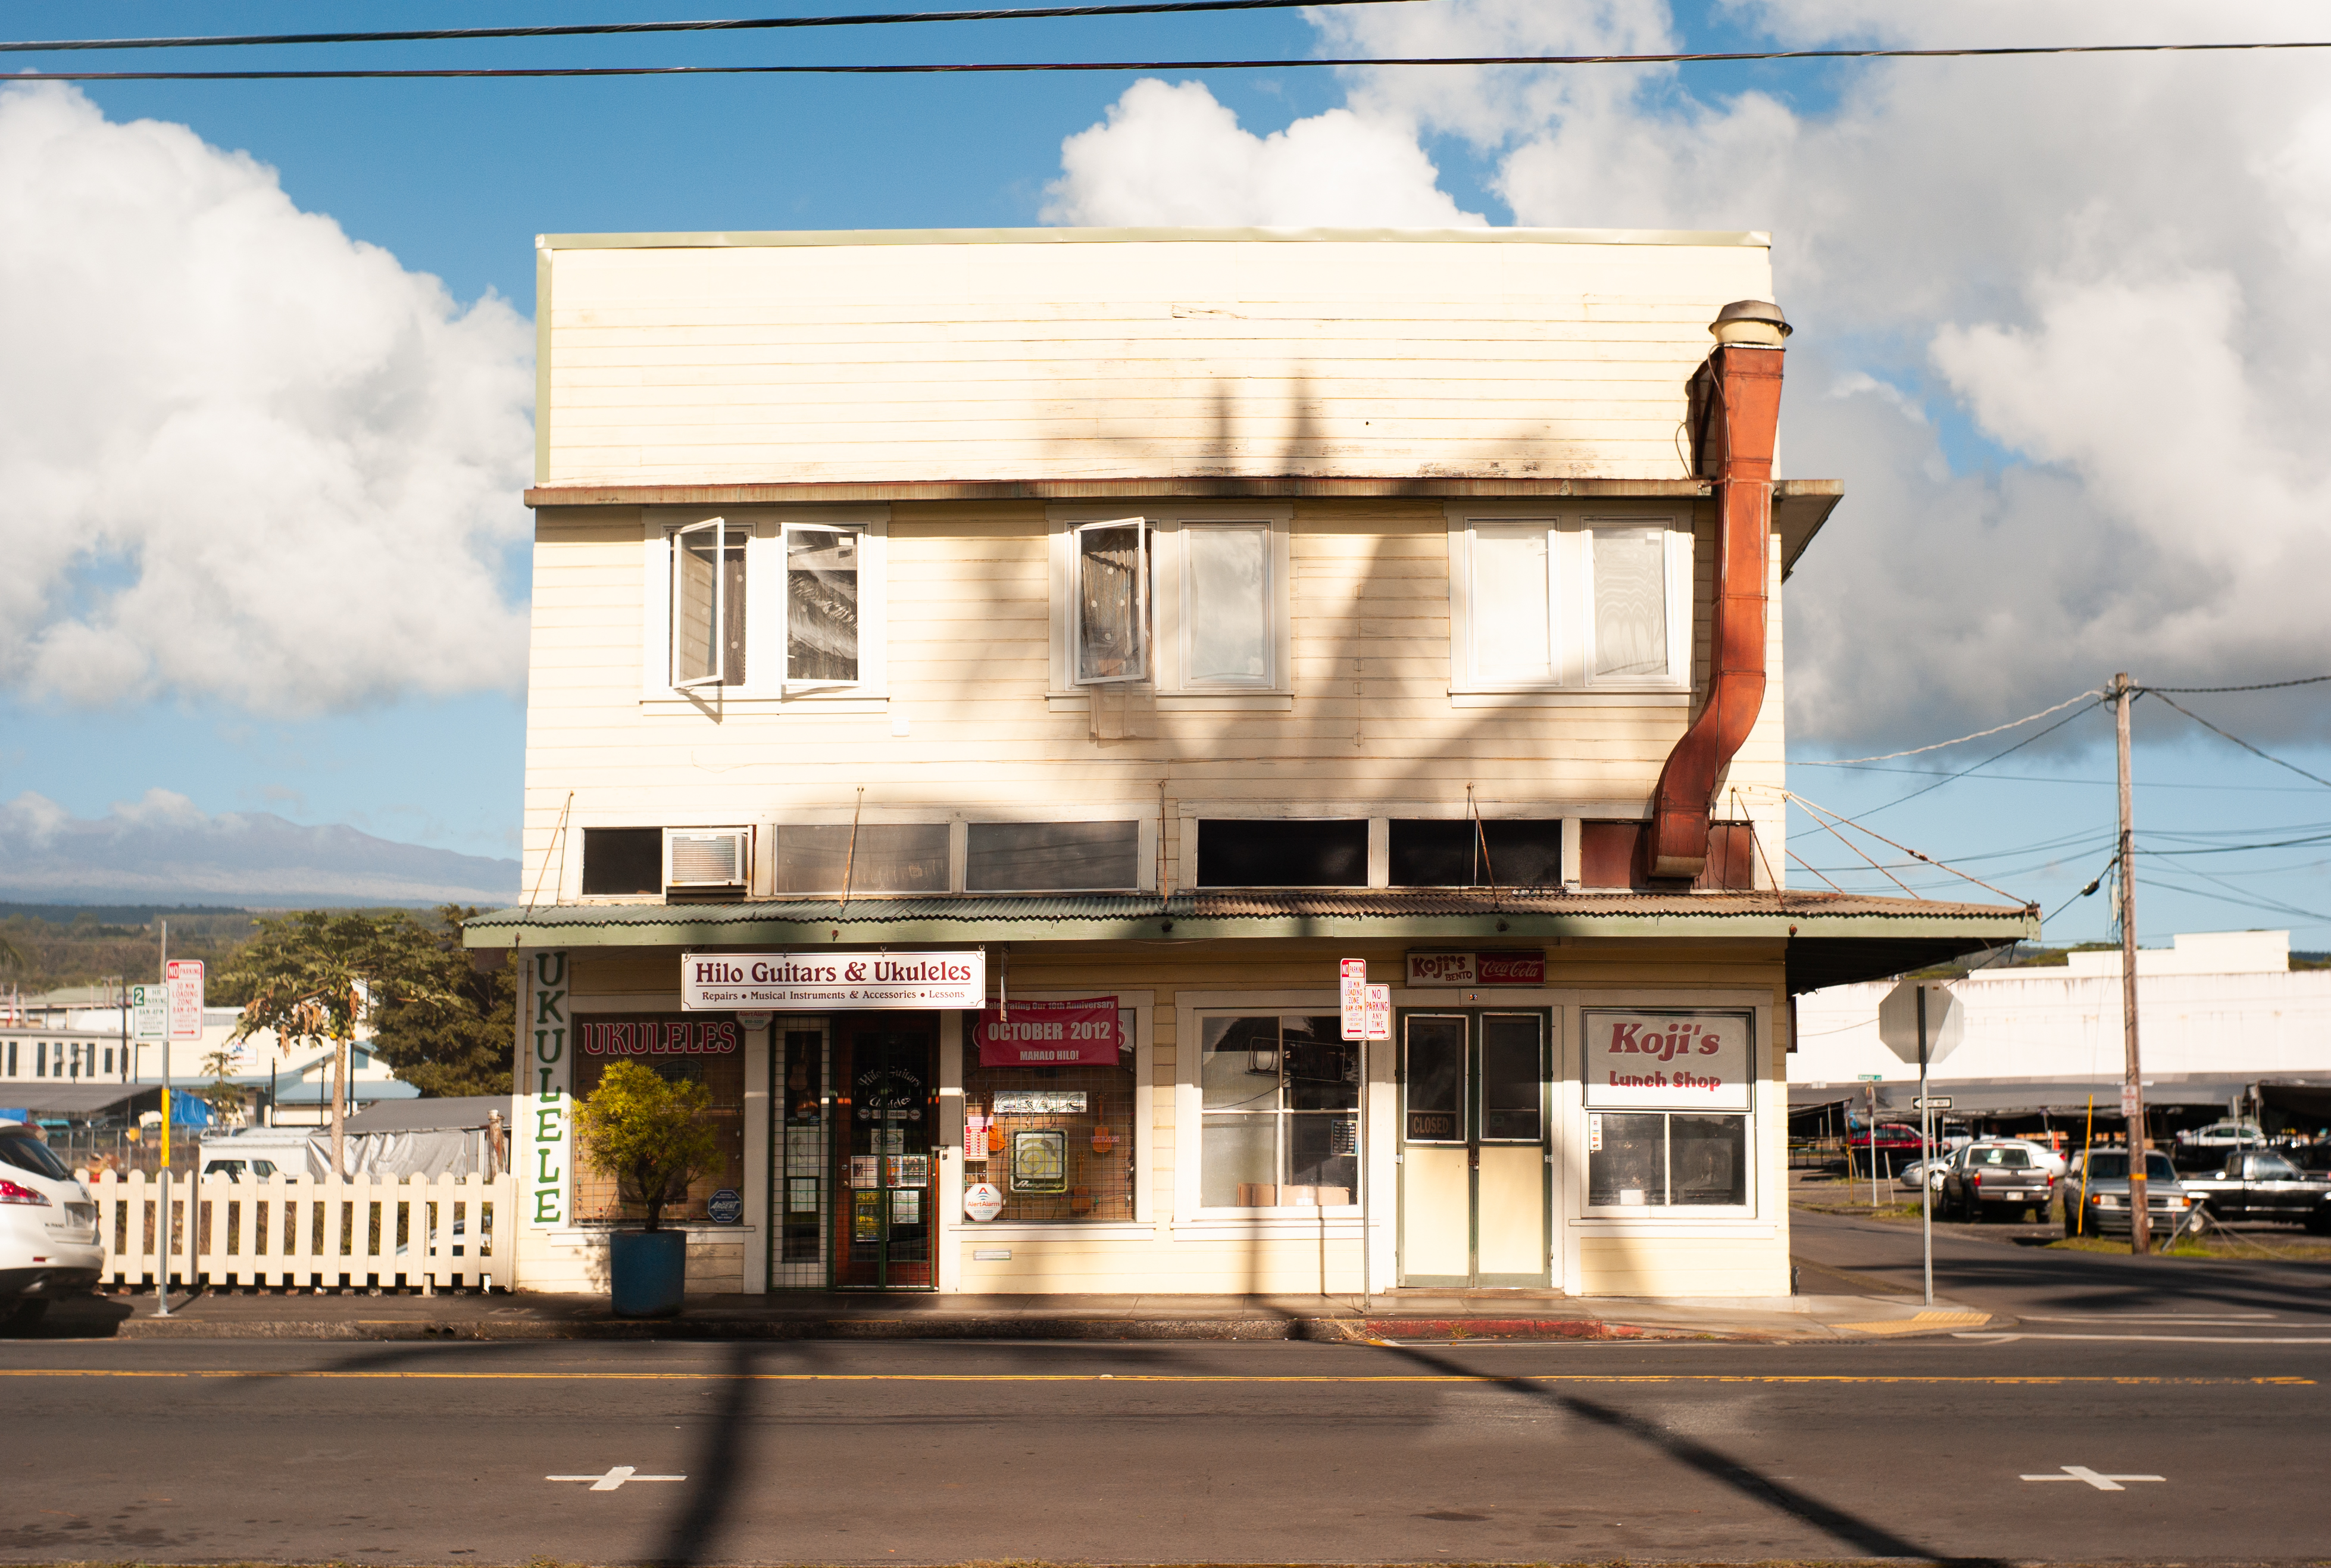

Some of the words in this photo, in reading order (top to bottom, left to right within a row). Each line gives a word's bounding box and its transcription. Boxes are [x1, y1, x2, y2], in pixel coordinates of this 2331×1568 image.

[168, 965, 178, 977] NO
[696, 962, 743, 983] Hilo
[751, 962, 837, 982] Guitars
[844, 961, 867, 982] &
[874, 961, 971, 982] Ukuleles
[1342, 964, 1349, 975] NO
[1411, 955, 1466, 978] Koji's
[1482, 960, 1539, 977] Coca-Cola
[1445, 970, 1473, 982] BENTO
[135, 988, 143, 1005] 2
[172, 991, 198, 999] LOADING
[702, 991, 738, 1002] Repairs
[751, 991, 786, 1000] Musical
[790, 991, 845, 1000] Instruments
[849, 991, 858, 999] &
[863, 990, 916, 999] Accessories
[929, 990, 965, 998] Lessons
[1372, 989, 1382, 999] NO
[145, 998, 167, 1006] PARKING
[177, 999, 193, 1007] ZONE
[985, 1001, 1030, 1011] Celerating
[1066, 1001, 1115, 1010] Anniversary
[1366, 1001, 1388, 1011] PARKING
[988, 1022, 1063, 1041] OCTOBER
[1070, 1022, 1111, 1040] 2012
[583, 1022, 736, 1055] UKULELES
[1608, 1023, 1720, 1062] Koji's
[1020, 1051, 1055, 1061] MAHALO
[1057, 1050, 1079, 1060] HILO!
[535, 951, 567, 1223] UKULELE
[1609, 1070, 1667, 1088] Lunch
[1673, 1071, 1721, 1092] Shop
[1413, 1116, 1449, 1134] CLOSED
[711, 1201, 740, 1209] ARGENT
